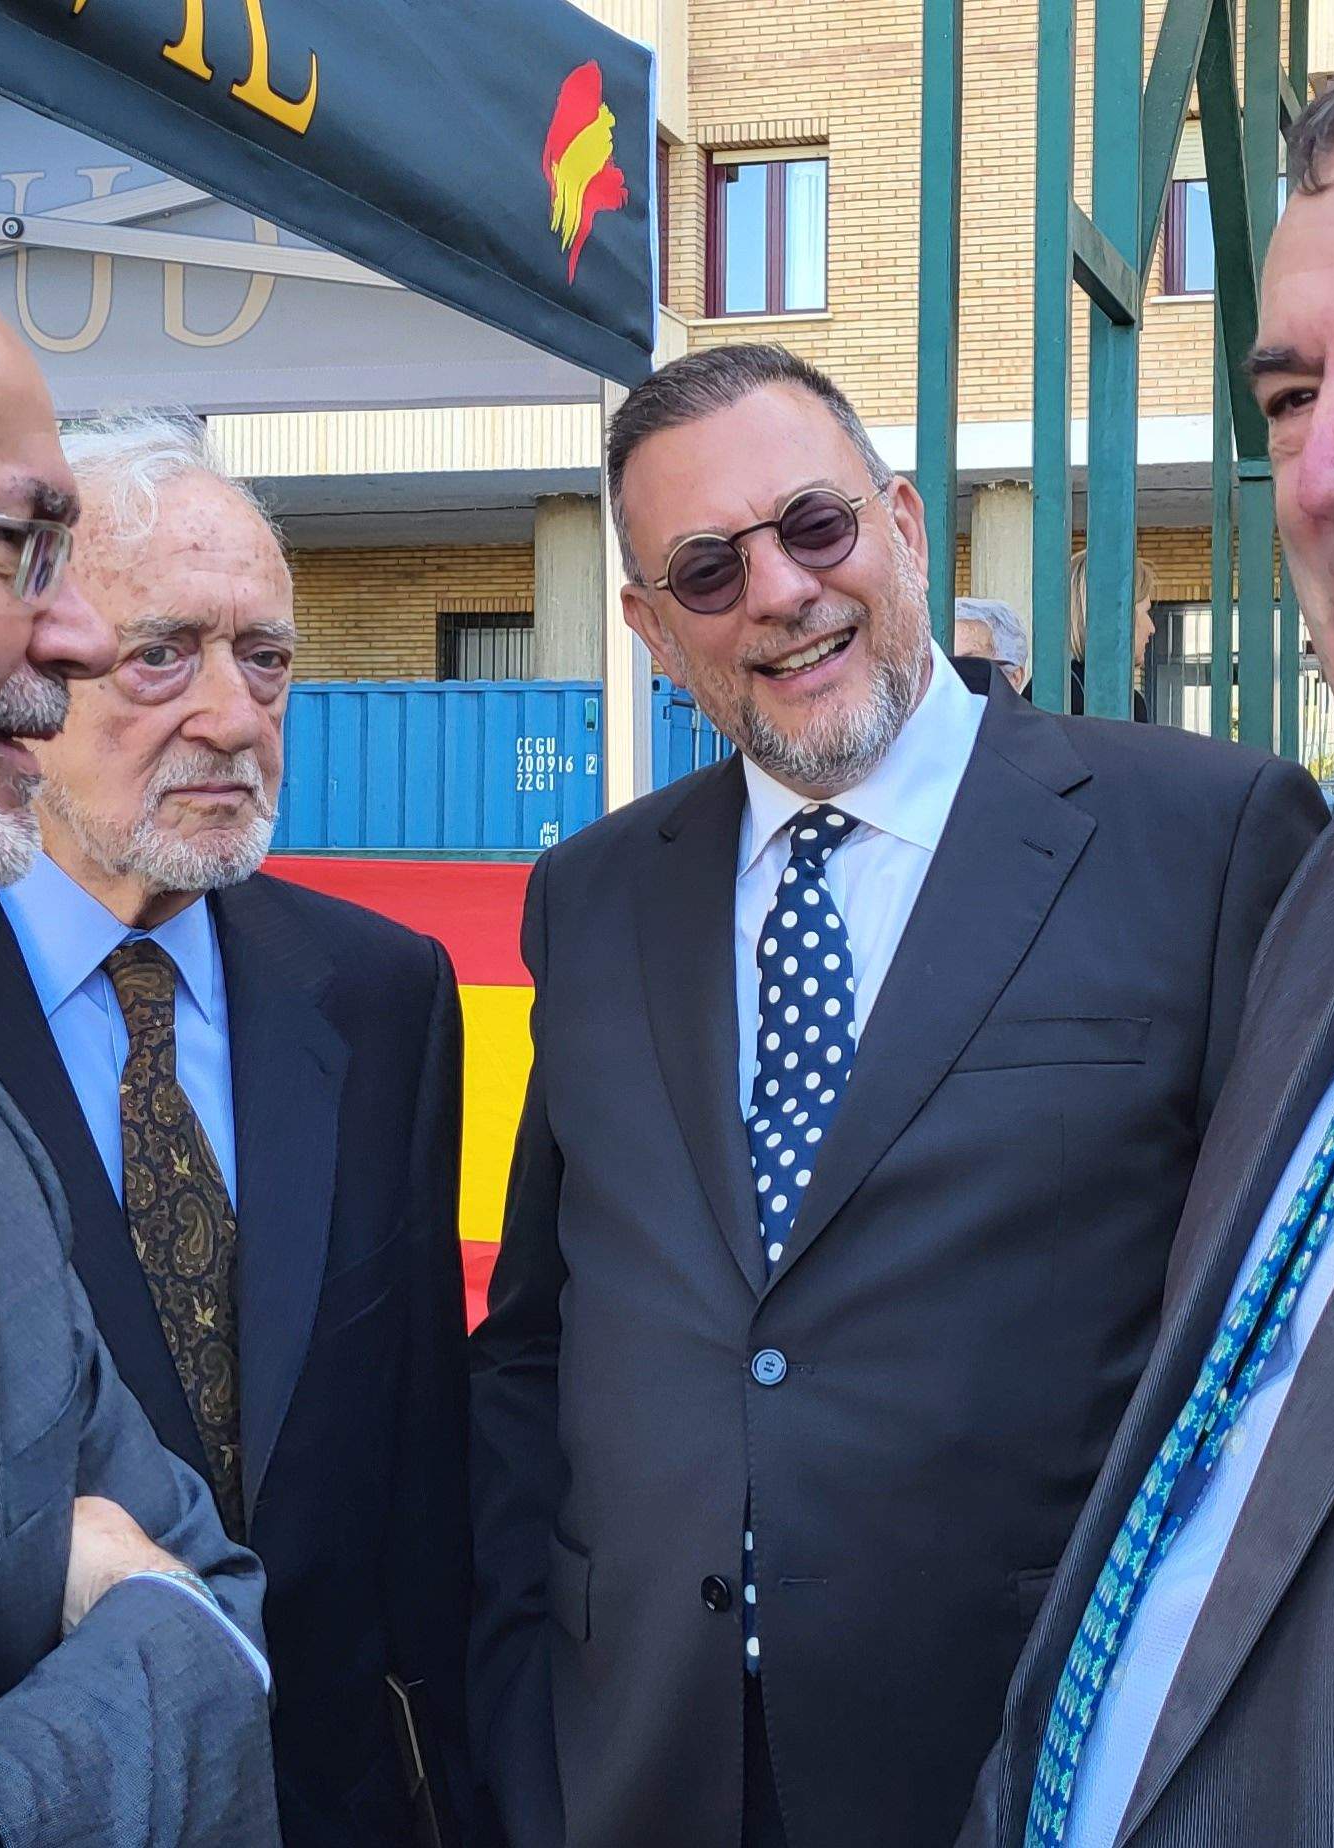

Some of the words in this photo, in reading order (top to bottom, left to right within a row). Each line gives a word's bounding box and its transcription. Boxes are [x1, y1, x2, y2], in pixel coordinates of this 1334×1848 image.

[517, 737, 555, 754] CCGU
[517, 755, 574, 773] 200916
[587, 755, 597, 773] 2
[517, 773, 555, 791] 22G1
